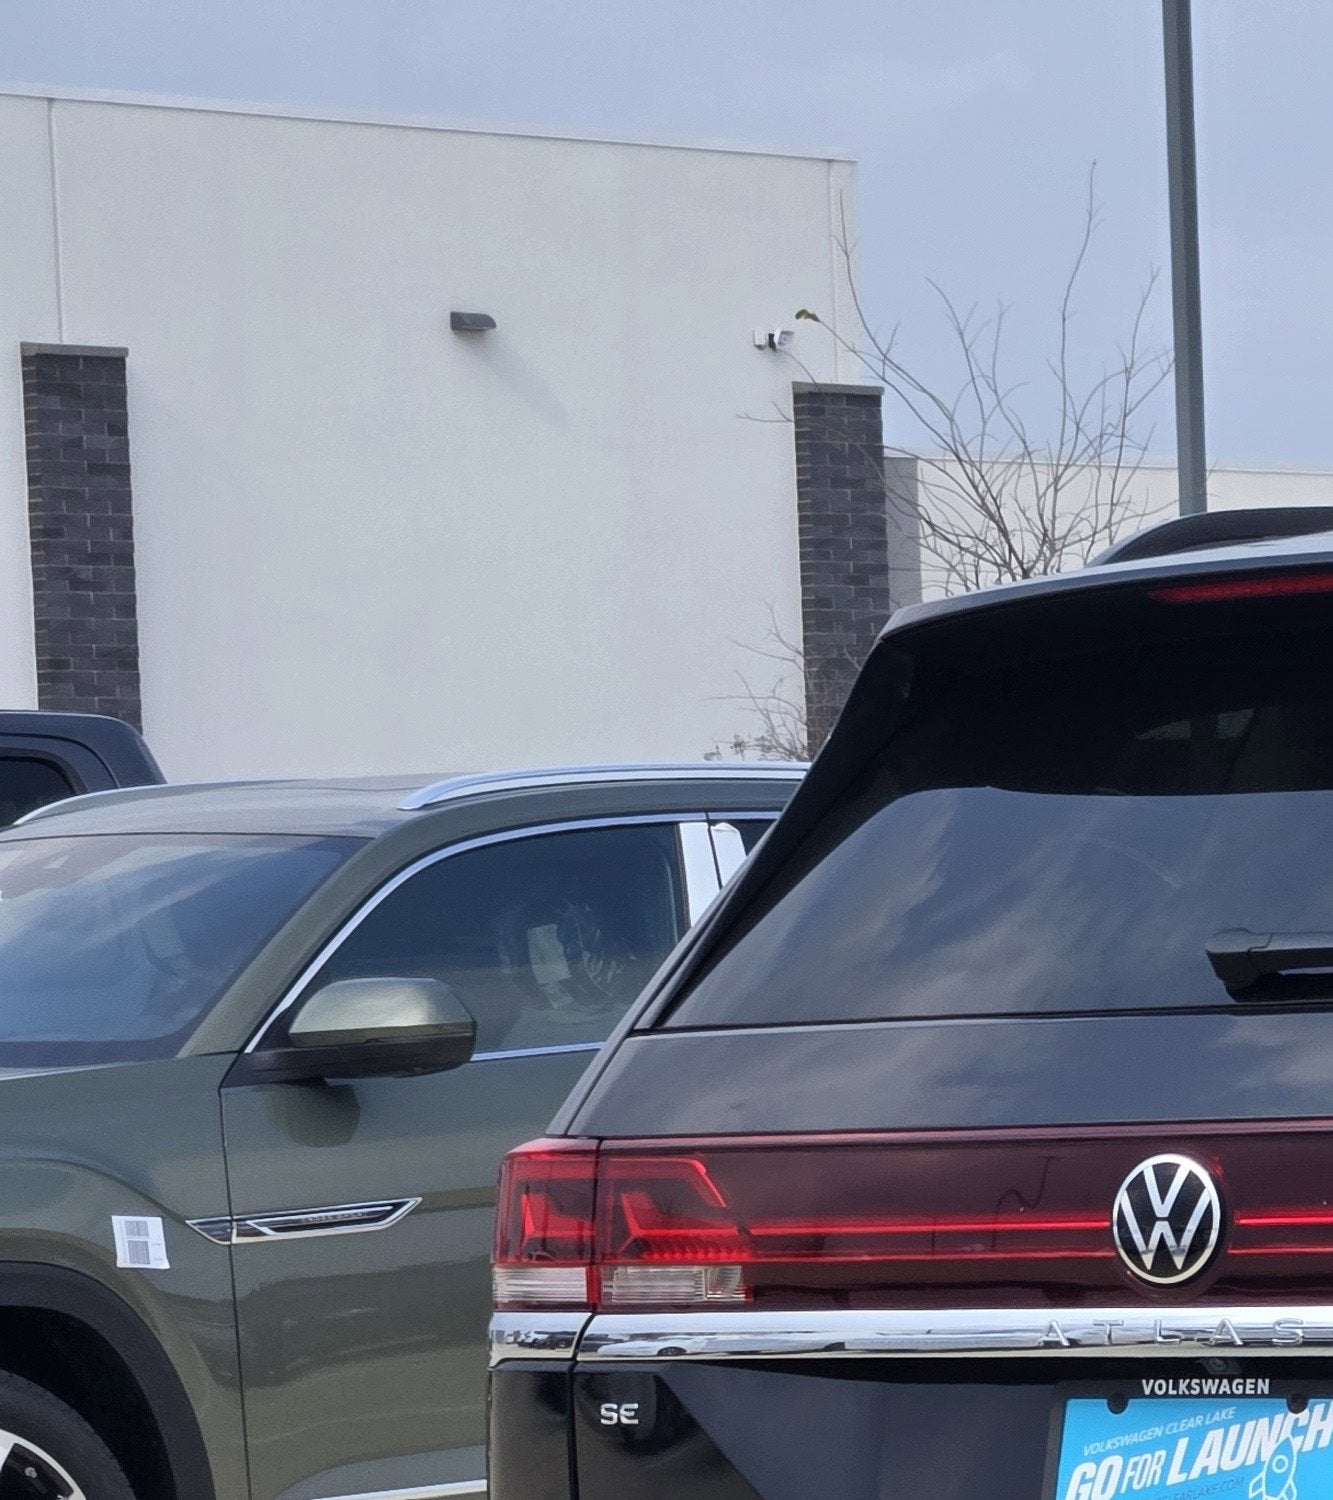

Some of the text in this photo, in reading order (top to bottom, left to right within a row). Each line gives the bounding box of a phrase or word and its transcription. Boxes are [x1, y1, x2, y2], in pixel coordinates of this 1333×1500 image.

[1038, 1317, 1305, 1347] ATLAS
[1142, 1378, 1270, 1396] VOLKSWAGEN
[600, 1402, 639, 1425] SE
[1083, 1406, 1237, 1457] VOLKSWAGEN CLEAR LAKE
[1120, 1449, 1167, 1494] FOR
